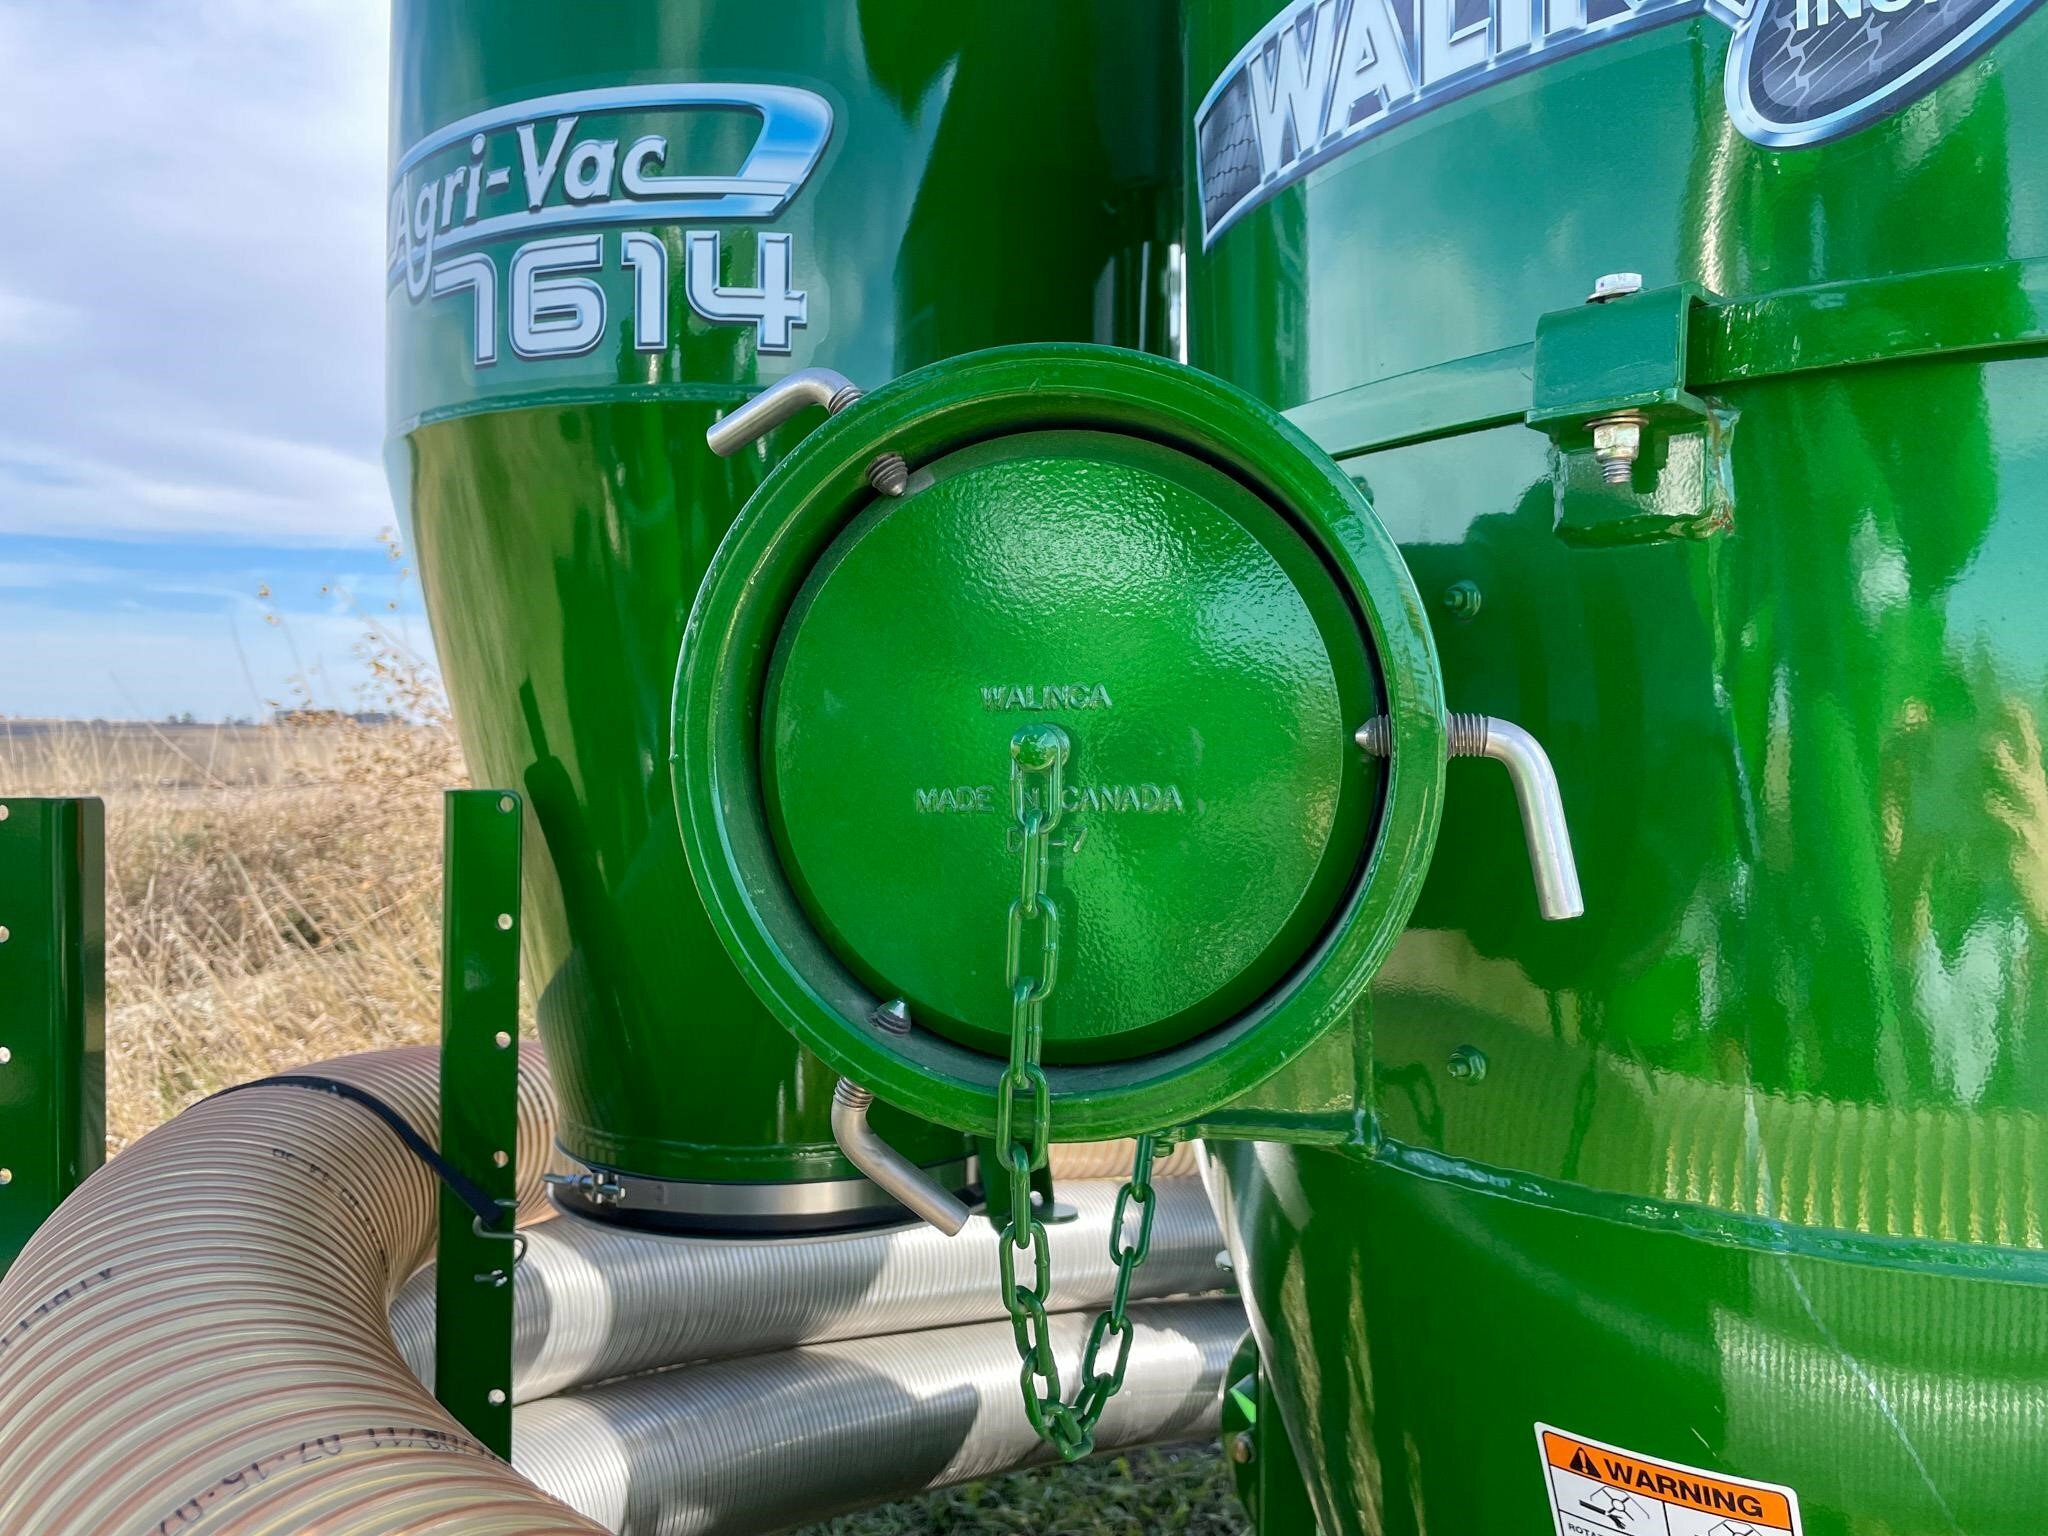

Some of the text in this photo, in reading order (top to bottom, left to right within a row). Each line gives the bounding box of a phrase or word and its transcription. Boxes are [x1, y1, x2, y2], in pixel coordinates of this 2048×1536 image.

[389, 117, 672, 298] Agri-Vac
[432, 231, 807, 364] 7614
[916, 785, 994, 813] MADE
[1061, 782, 1184, 812] CANADA
[1604, 1458, 1763, 1518] WARNING
